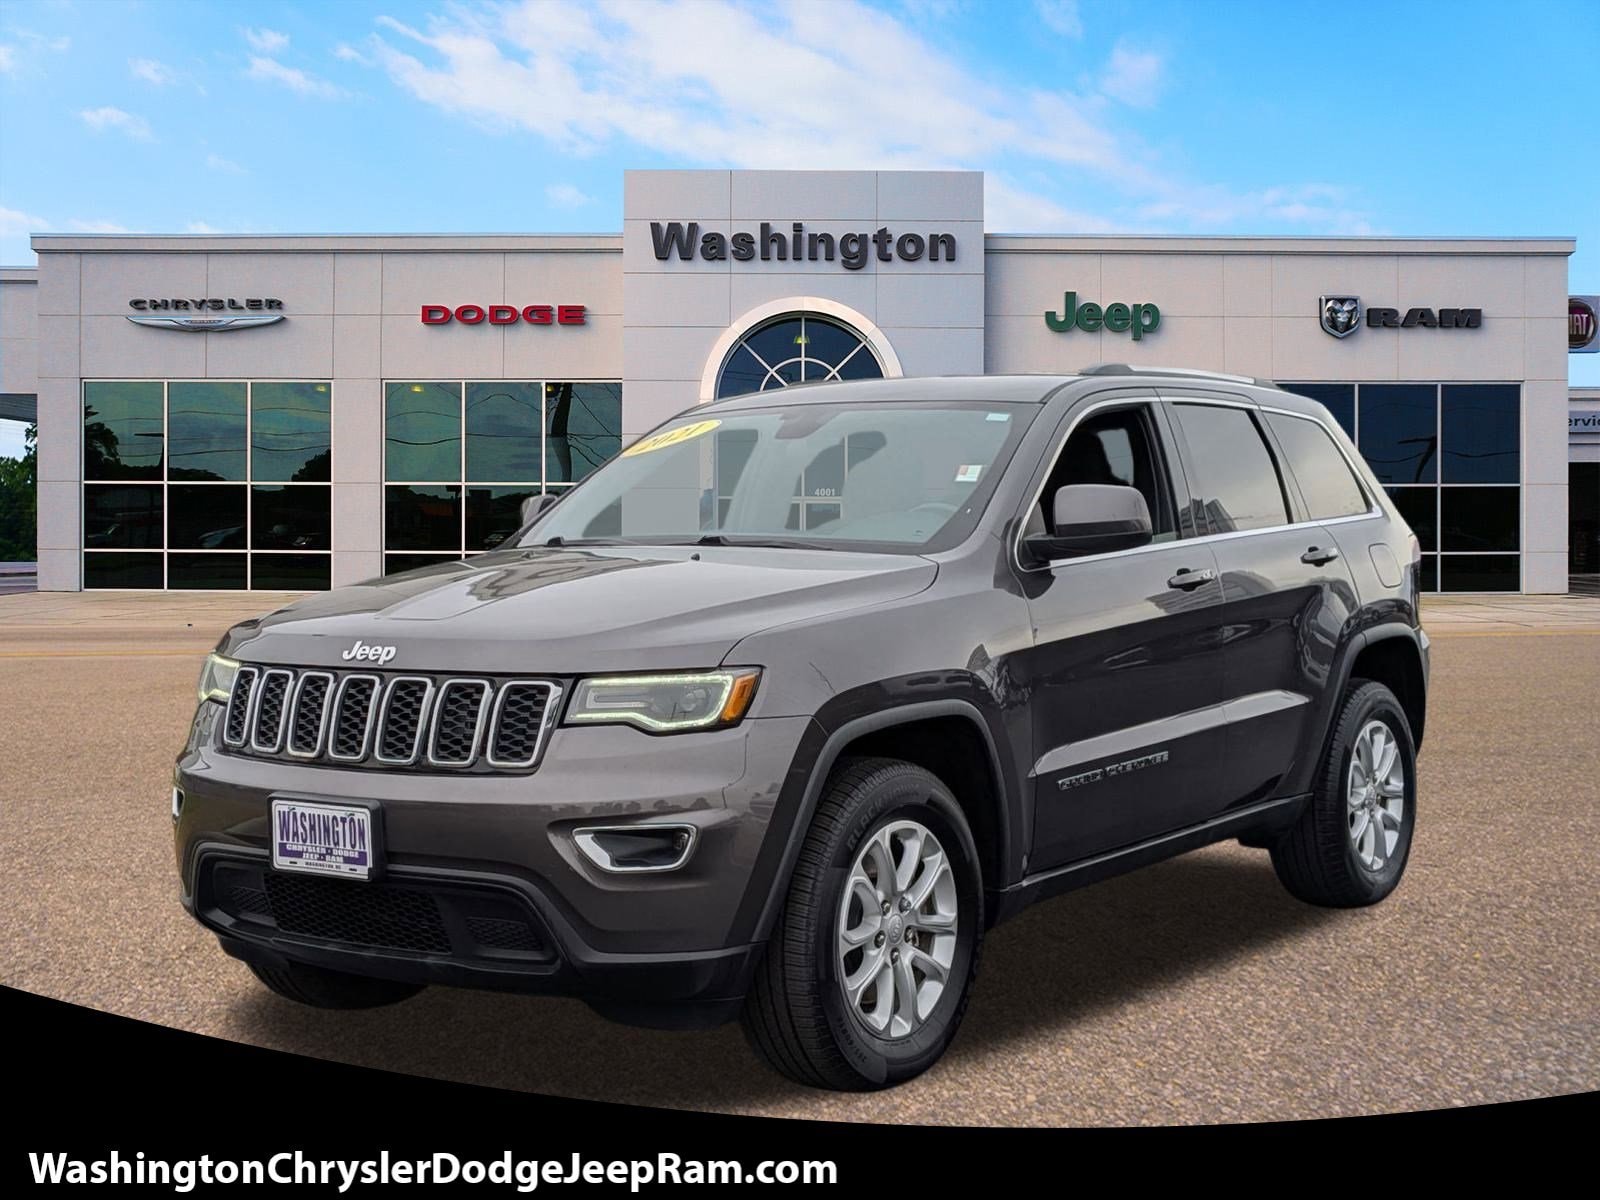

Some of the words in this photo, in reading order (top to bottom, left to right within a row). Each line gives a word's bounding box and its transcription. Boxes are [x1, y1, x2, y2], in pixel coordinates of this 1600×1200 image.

[650, 222, 956, 270] Washington
[129, 298, 283, 311] CHRYSLER
[421, 304, 586, 326] DODGE
[1045, 291, 1161, 341] Jeep
[1366, 307, 1482, 328] RAM
[1568, 313, 1589, 336] IAT
[814, 487, 836, 497] 4001
[342, 640, 396, 665] Jeep
[278, 810, 366, 850] WASHINGTON
[333, 849, 359, 858] DODGE
